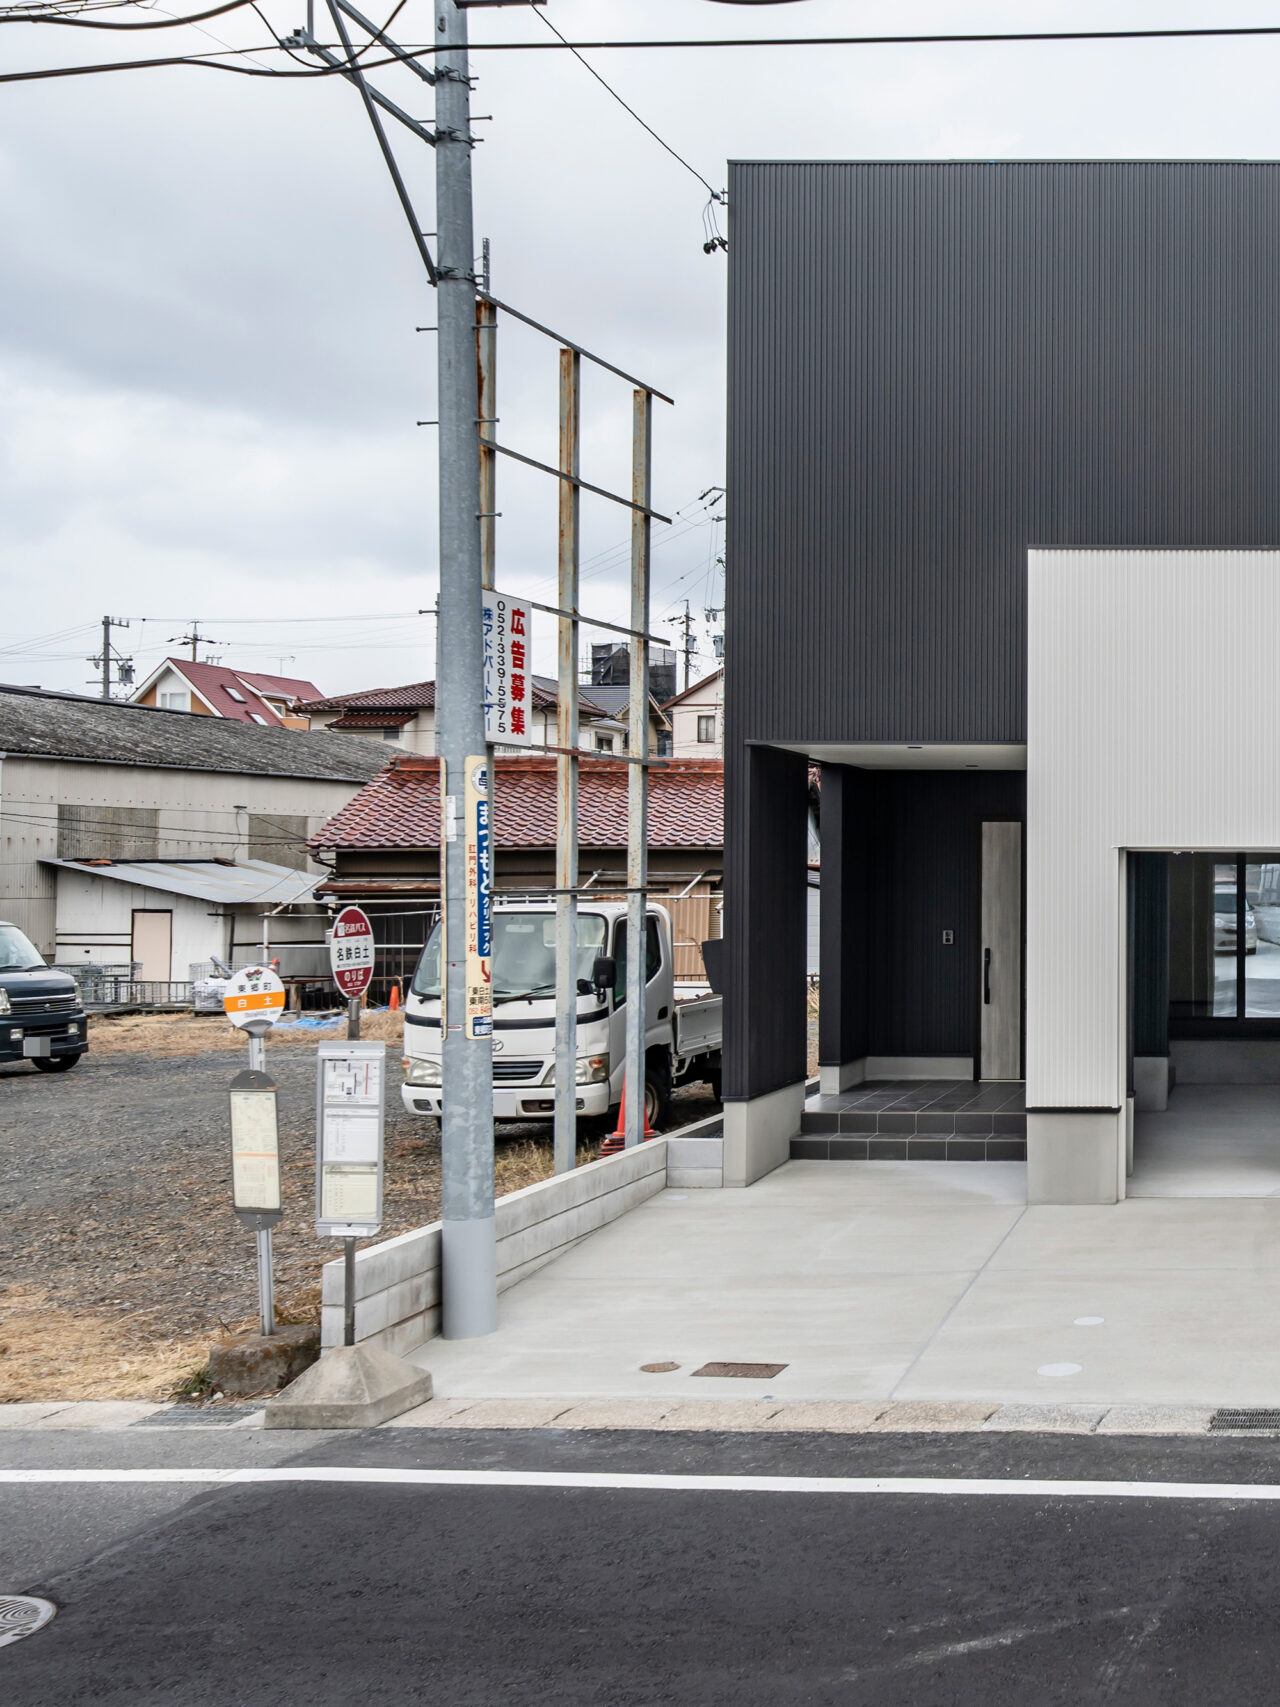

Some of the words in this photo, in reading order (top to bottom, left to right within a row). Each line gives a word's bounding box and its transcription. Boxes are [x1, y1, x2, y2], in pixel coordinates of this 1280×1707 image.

[497, 600, 506, 734] 052-339-5575
[511, 608, 526, 735] 広告募集
[337, 945, 370, 961] 名鉄白土
[344, 969, 365, 982] のりば
